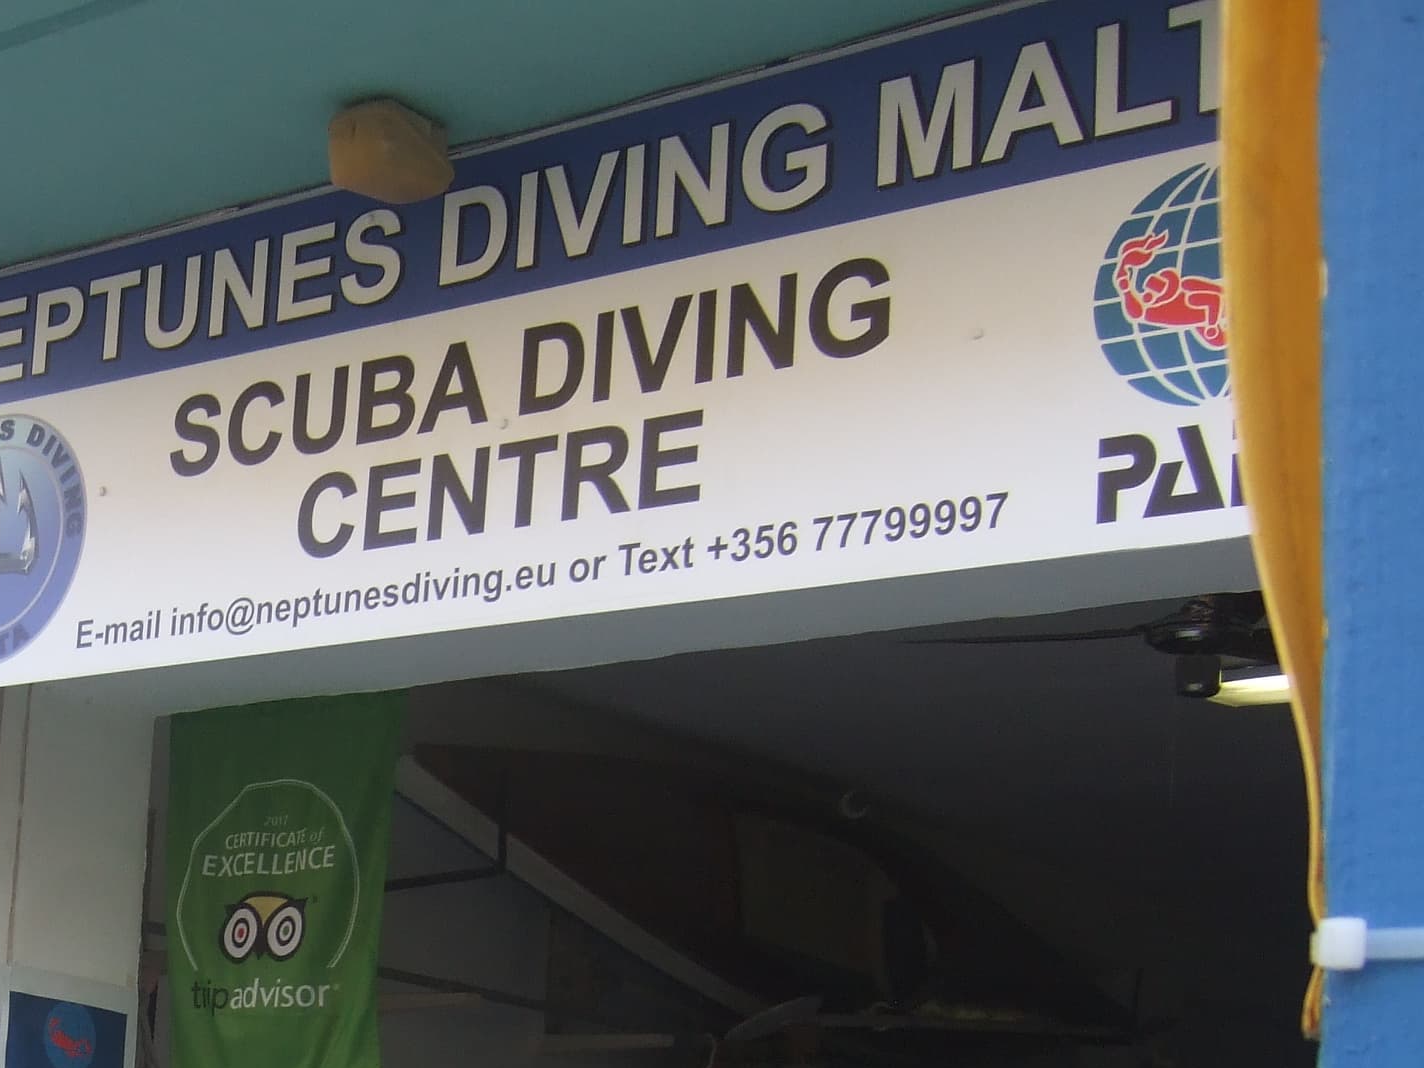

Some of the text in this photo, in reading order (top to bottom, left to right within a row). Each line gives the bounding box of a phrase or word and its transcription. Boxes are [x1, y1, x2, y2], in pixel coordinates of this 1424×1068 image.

[437, 101, 832, 289] DIVING
[168, 257, 891, 478] SCUBA DIVING
[26, 422, 83, 538] DIVING
[296, 409, 704, 558] CENTRE
[1096, 420, 1245, 524] PA
[75, 491, 1010, 651] E-mail info@neptunesdiving.eu or Text +356 77799997
[201, 844, 336, 877] EXCELLENCE
[225, 827, 307, 850] CERTIFICATE
